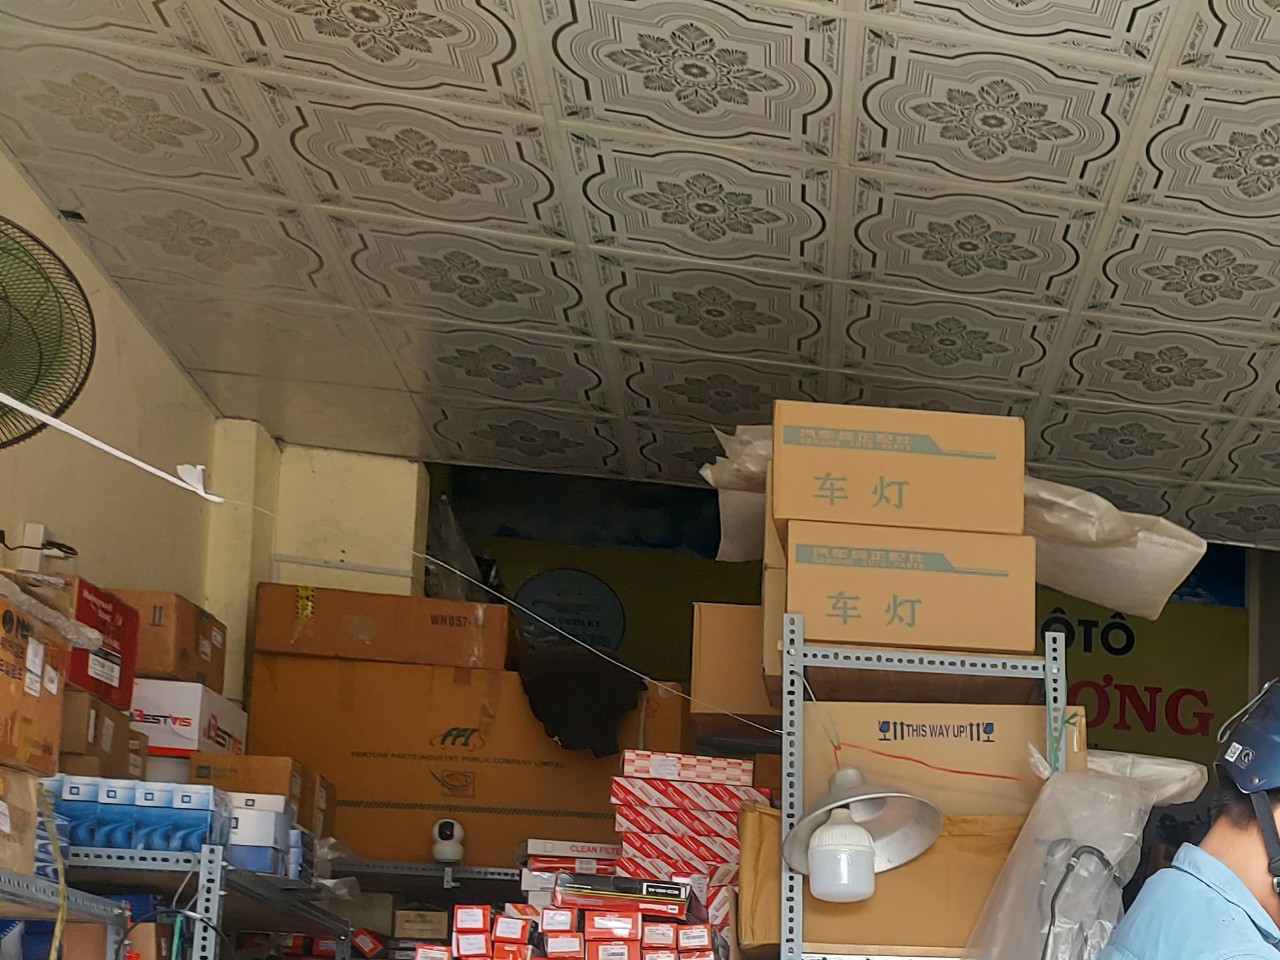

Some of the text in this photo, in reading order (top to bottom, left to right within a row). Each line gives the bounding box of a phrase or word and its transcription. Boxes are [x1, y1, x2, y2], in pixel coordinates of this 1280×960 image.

[906, 724, 968, 739] THIS WAY UP!
[570, 845, 622, 856] CLEAN FILTE
